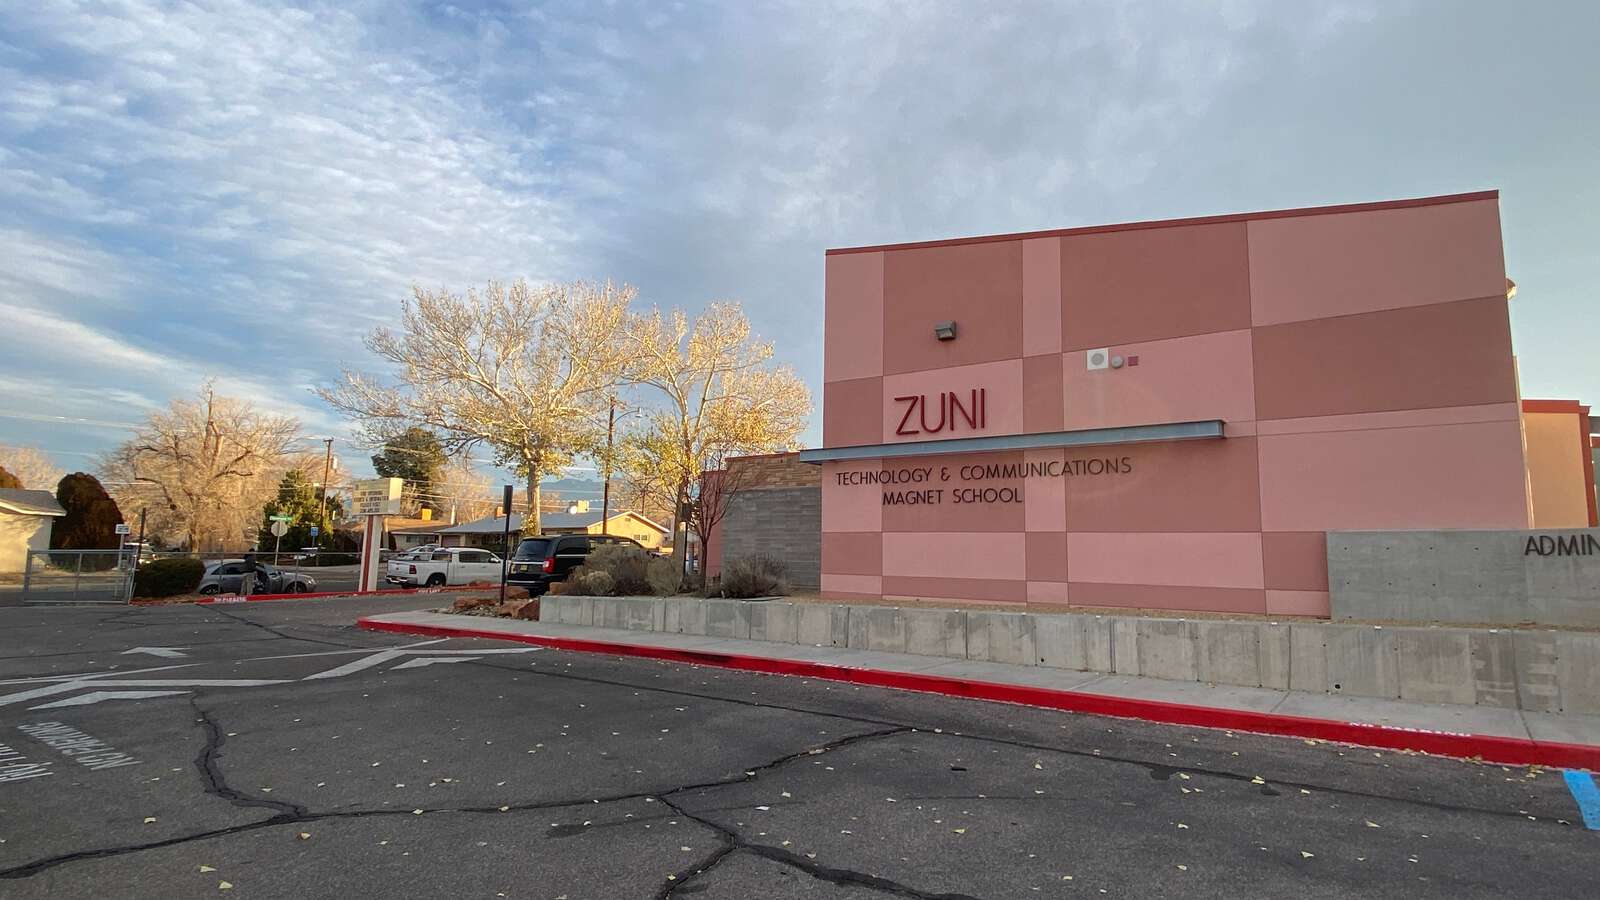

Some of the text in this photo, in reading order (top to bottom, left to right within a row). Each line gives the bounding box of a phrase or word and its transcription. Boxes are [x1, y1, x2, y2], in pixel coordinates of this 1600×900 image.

[894, 388, 986, 436] ZUNI
[836, 456, 1132, 486] TECHNOLOGY & COMMUNICATIONS
[882, 488, 1023, 506] MAGNET SCHOOL
[1524, 533, 1600, 556] ADMIN
